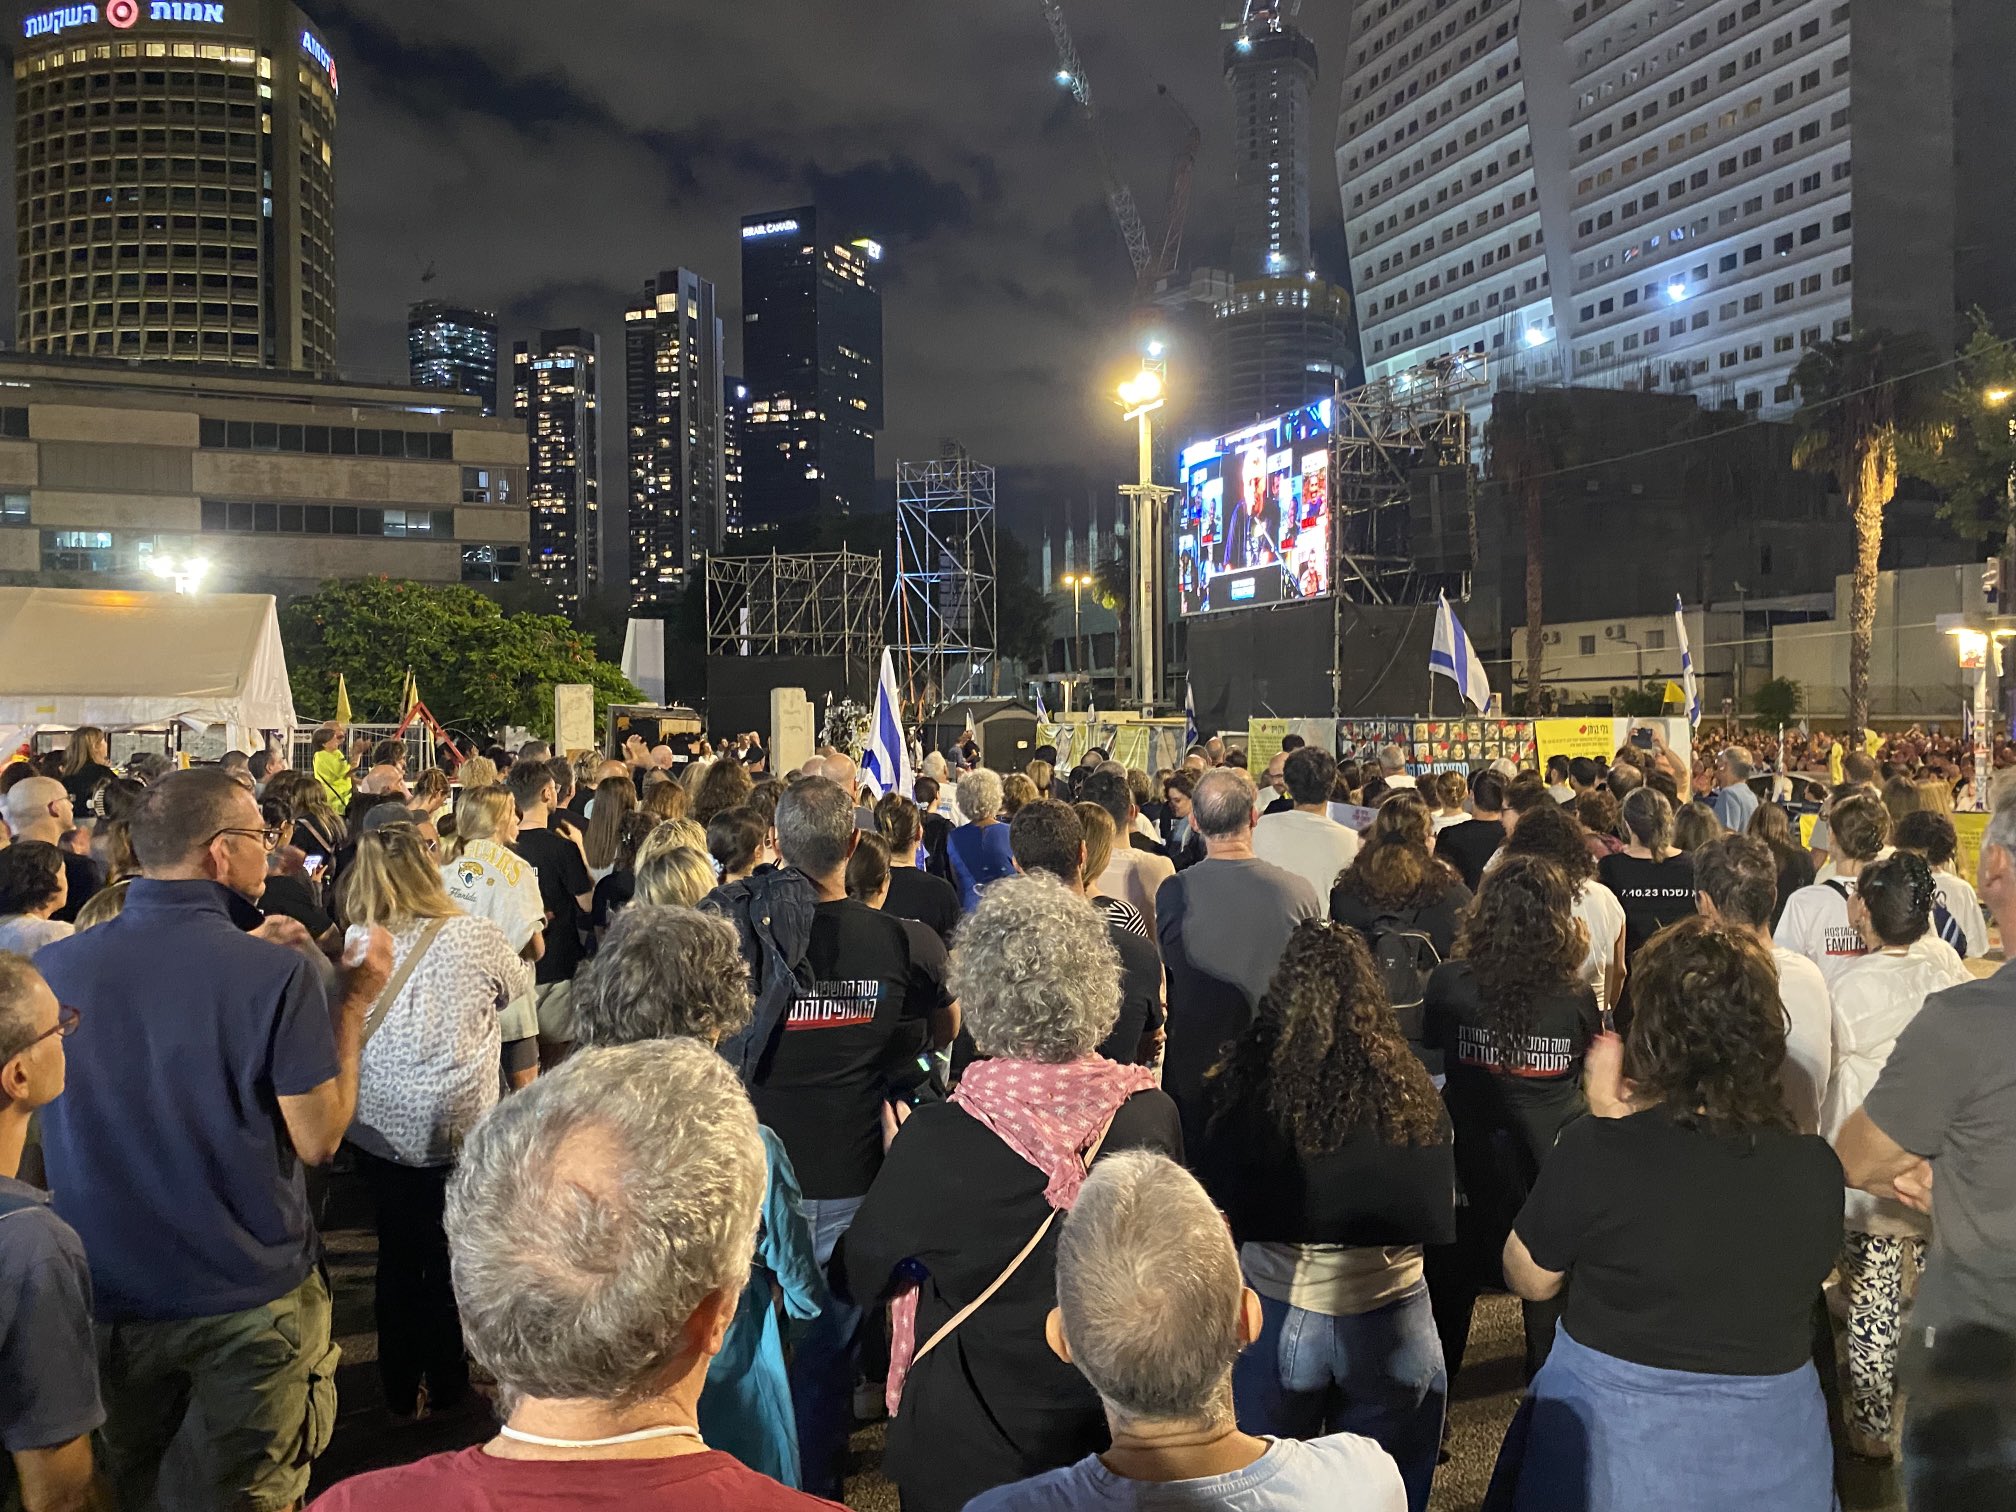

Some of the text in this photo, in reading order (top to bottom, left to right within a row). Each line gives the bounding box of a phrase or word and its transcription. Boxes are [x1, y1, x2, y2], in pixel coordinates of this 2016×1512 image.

[25, 0, 224, 38] אמות השקעות
[302, 31, 331, 73] AMOT
[448, 886, 478, 903] Florida
[1824, 926, 1858, 938] HOSTAG
[857, 980, 879, 996] מטה
[788, 998, 877, 1021] החטופים והנע
